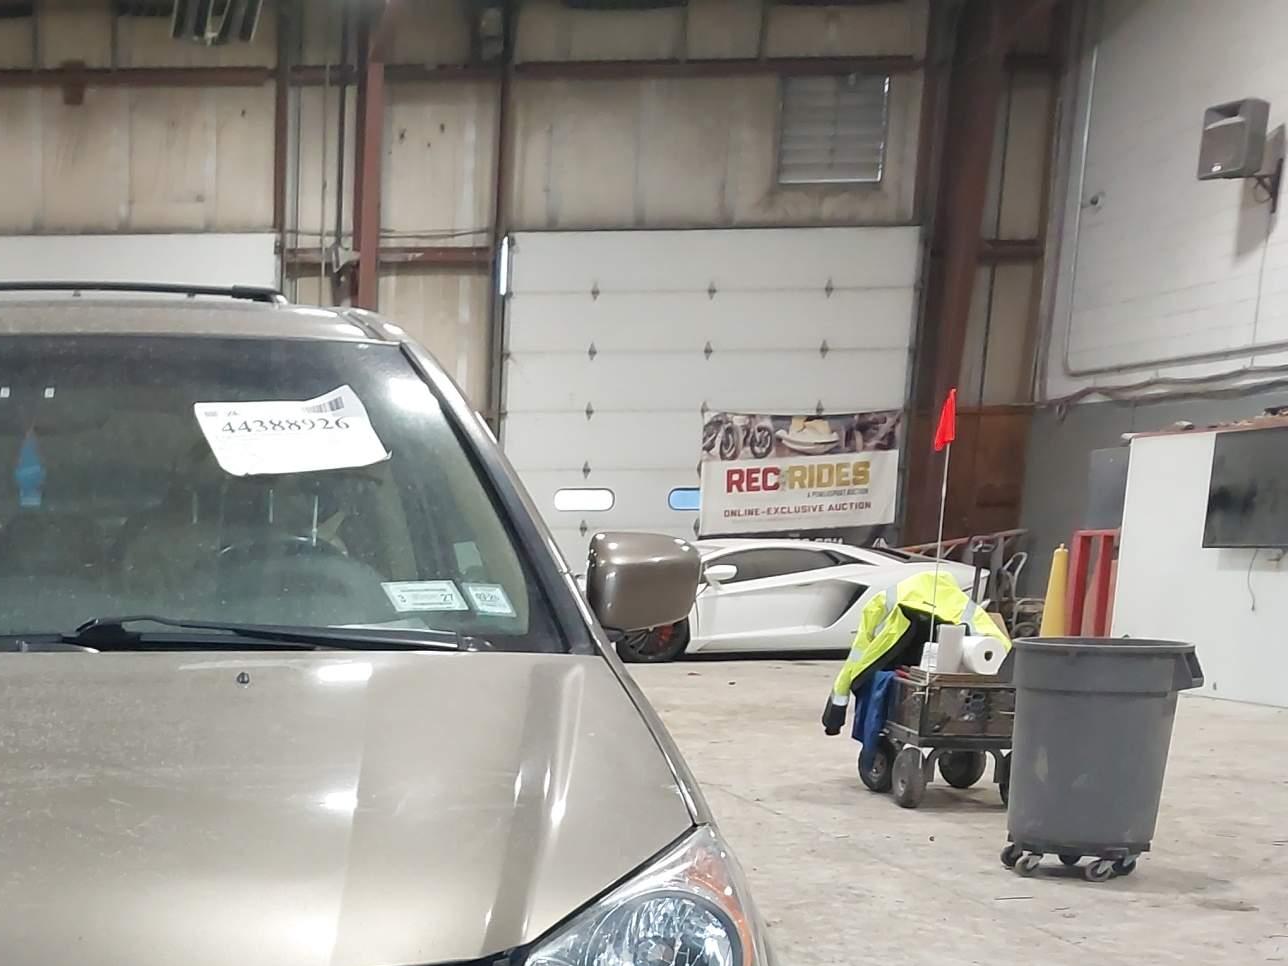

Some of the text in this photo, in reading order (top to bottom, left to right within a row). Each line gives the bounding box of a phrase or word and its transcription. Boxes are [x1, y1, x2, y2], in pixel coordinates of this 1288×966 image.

[222, 417, 350, 433] 44388926
[726, 467, 781, 493] REC
[788, 461, 871, 489] RIDES
[724, 501, 872, 518] ONLINE-EXCLUSIVE AUCTION
